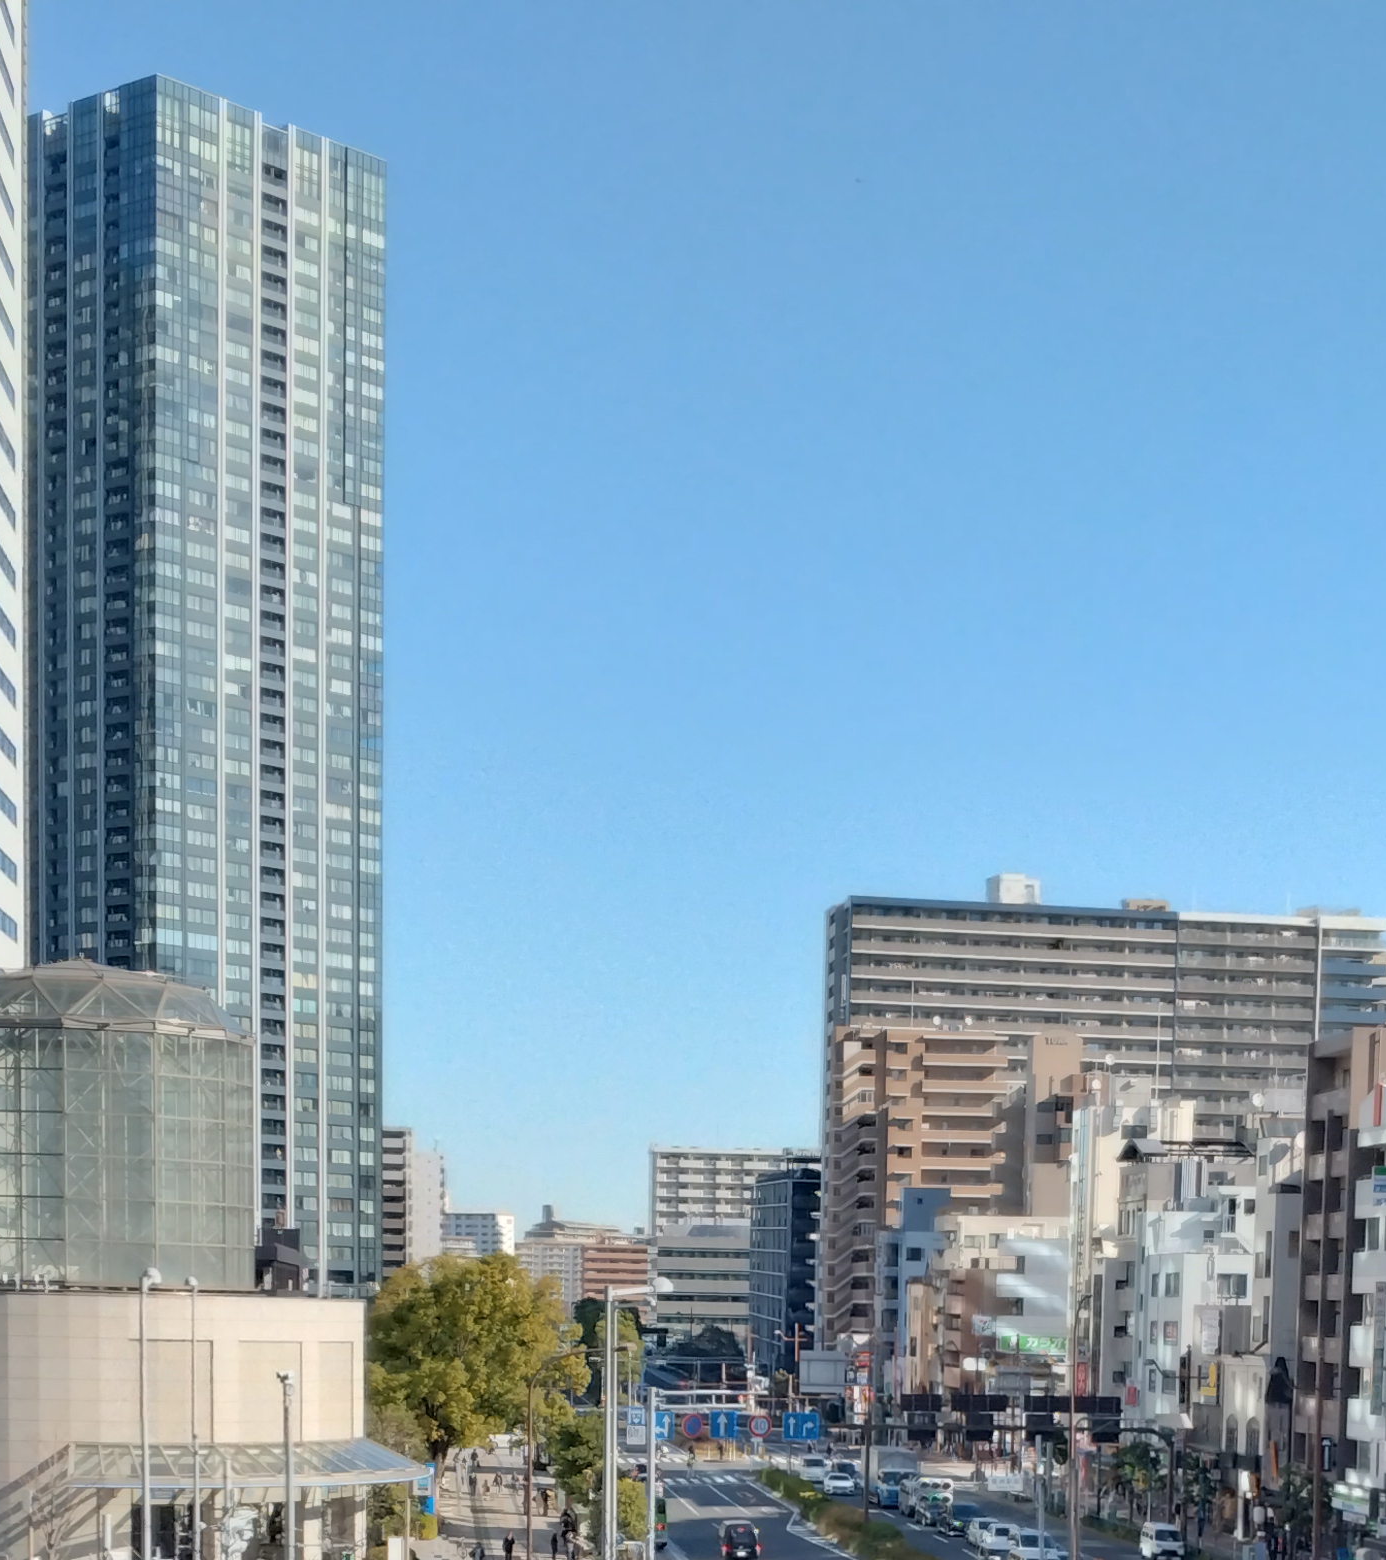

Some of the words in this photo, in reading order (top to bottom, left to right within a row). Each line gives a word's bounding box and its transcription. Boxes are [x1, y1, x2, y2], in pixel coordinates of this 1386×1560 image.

[1026, 1337, 1066, 1350] カラオ
[754, 1419, 766, 1430] 40
